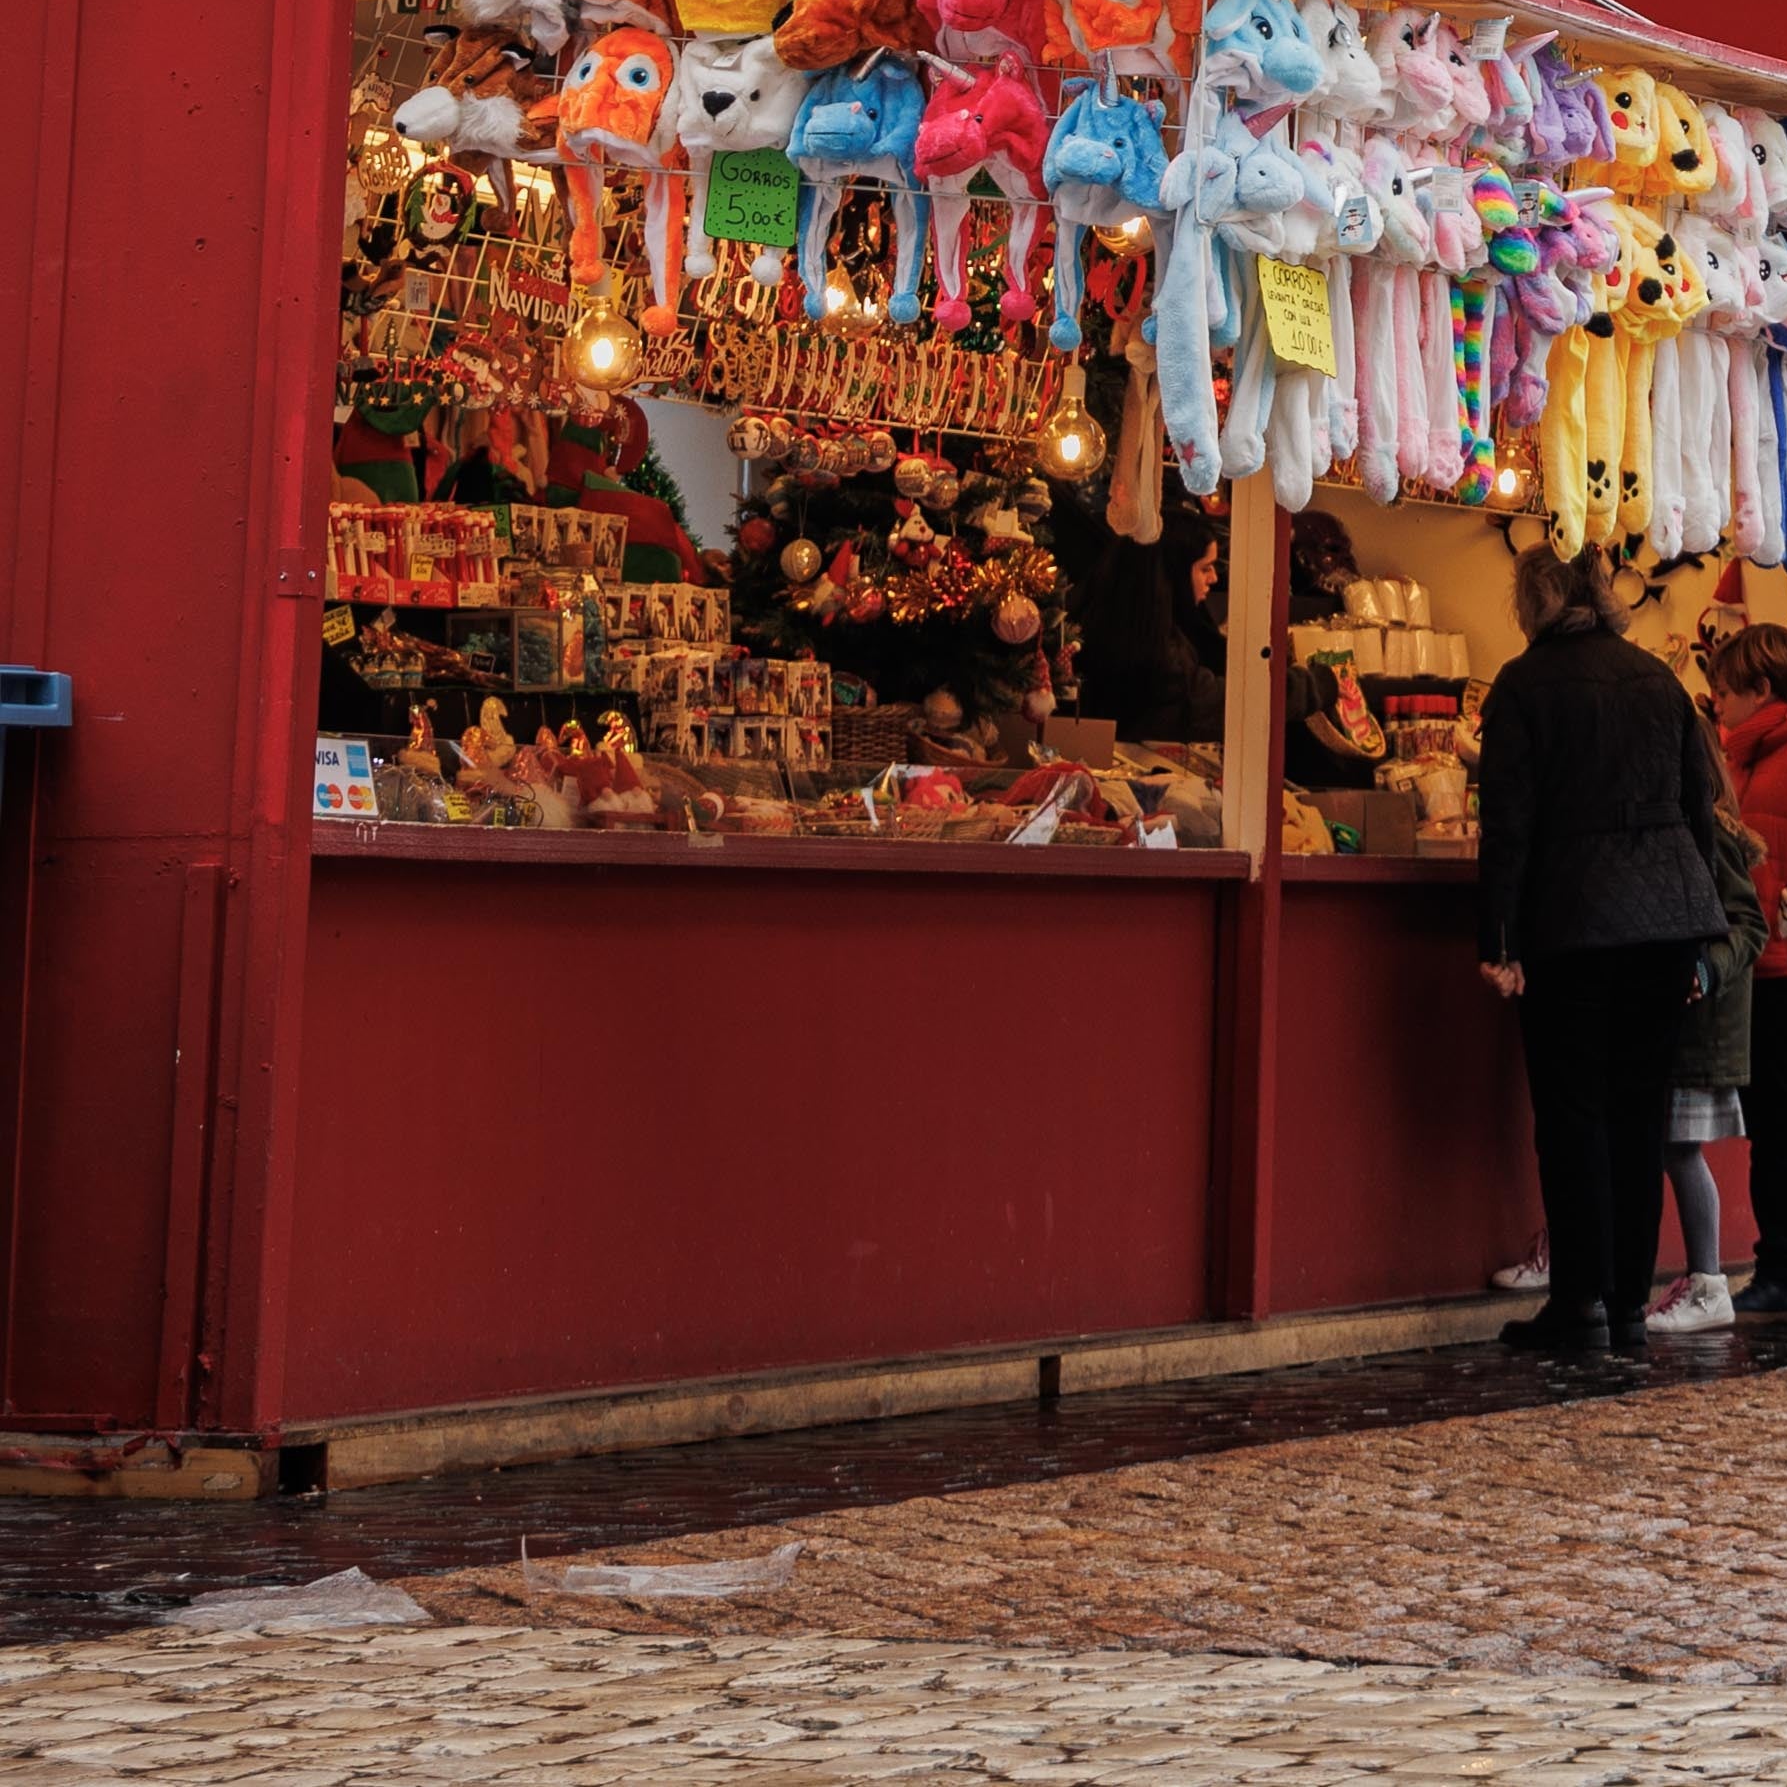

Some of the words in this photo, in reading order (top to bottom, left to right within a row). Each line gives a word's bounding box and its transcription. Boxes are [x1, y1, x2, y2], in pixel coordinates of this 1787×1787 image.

[720, 152, 791, 189] GORROS
[1273, 265, 1313, 295] GORROS
[315, 751, 340, 766] VISA
